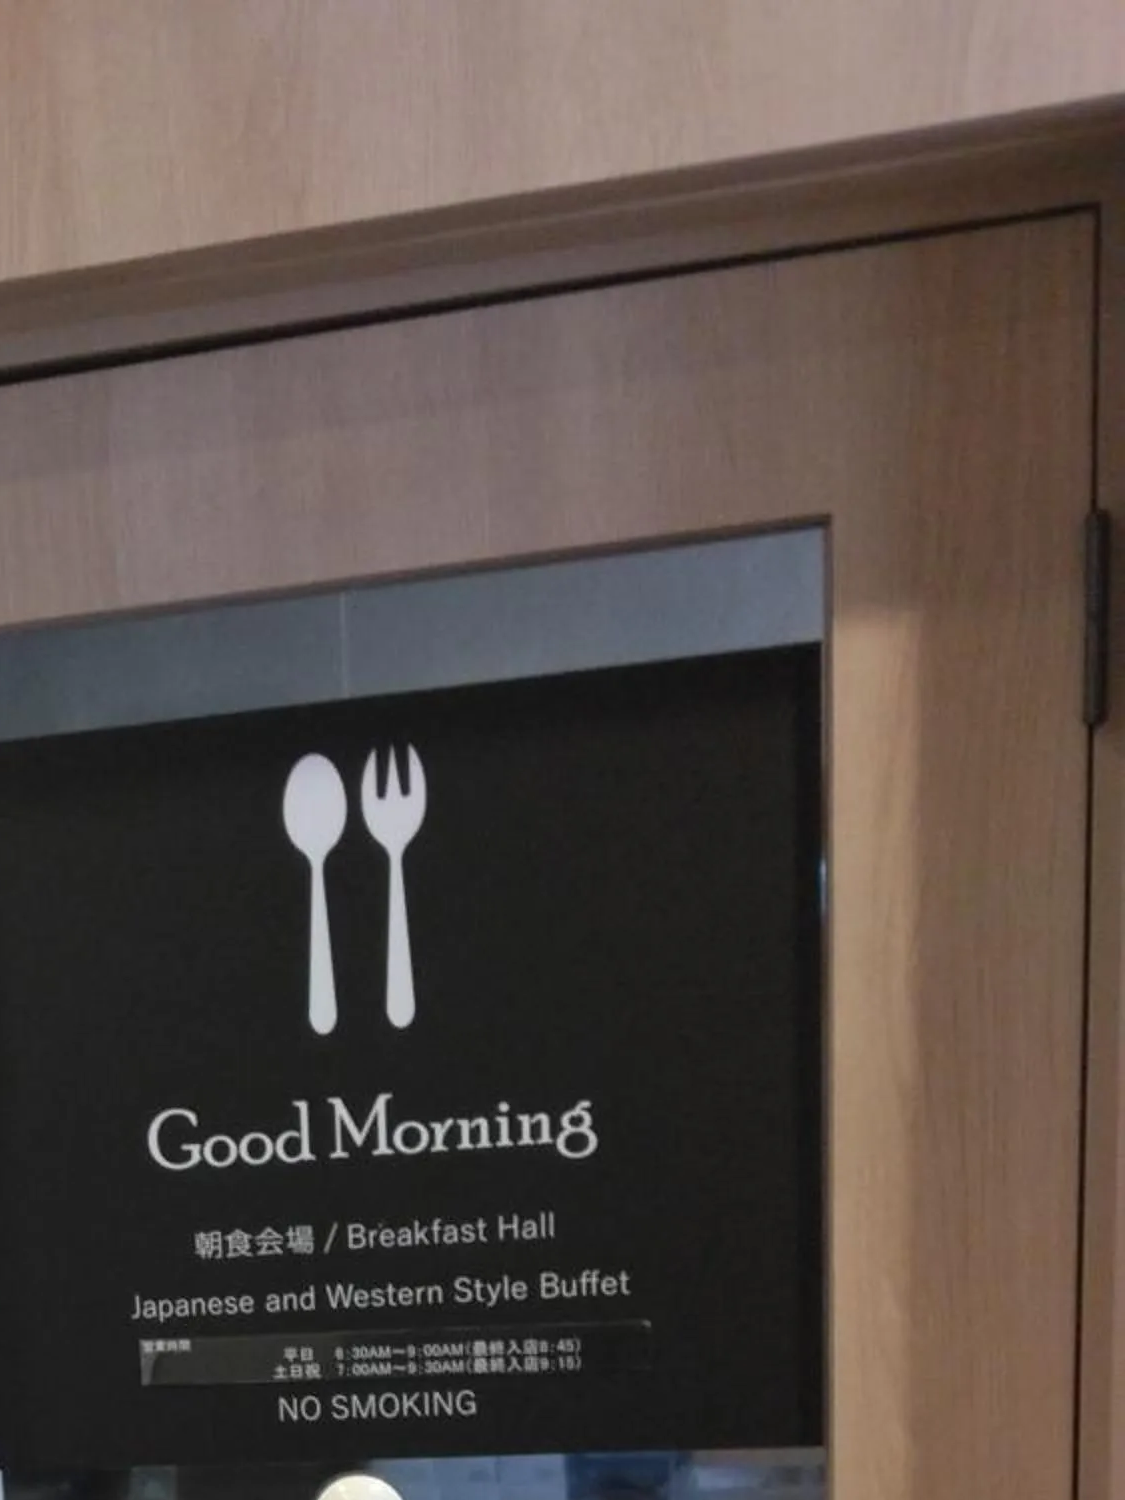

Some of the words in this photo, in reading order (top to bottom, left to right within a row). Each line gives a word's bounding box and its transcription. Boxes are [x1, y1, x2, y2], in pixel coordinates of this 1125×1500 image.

[147, 1099, 316, 1171] Good
[328, 1092, 599, 1160] Morning
[193, 1225, 315, 1260] 朝食会場
[323, 1221, 339, 1254] /
[346, 1217, 488, 1251] Breakfast
[497, 1211, 556, 1241] Hall
[131, 1293, 256, 1323] Japanese
[265, 1285, 316, 1313] and
[325, 1279, 444, 1310] Western
[453, 1274, 529, 1307] Style
[539, 1269, 632, 1298] Buffet
[278, 1395, 323, 1422] NO
[331, 1389, 478, 1420] SMOKING
